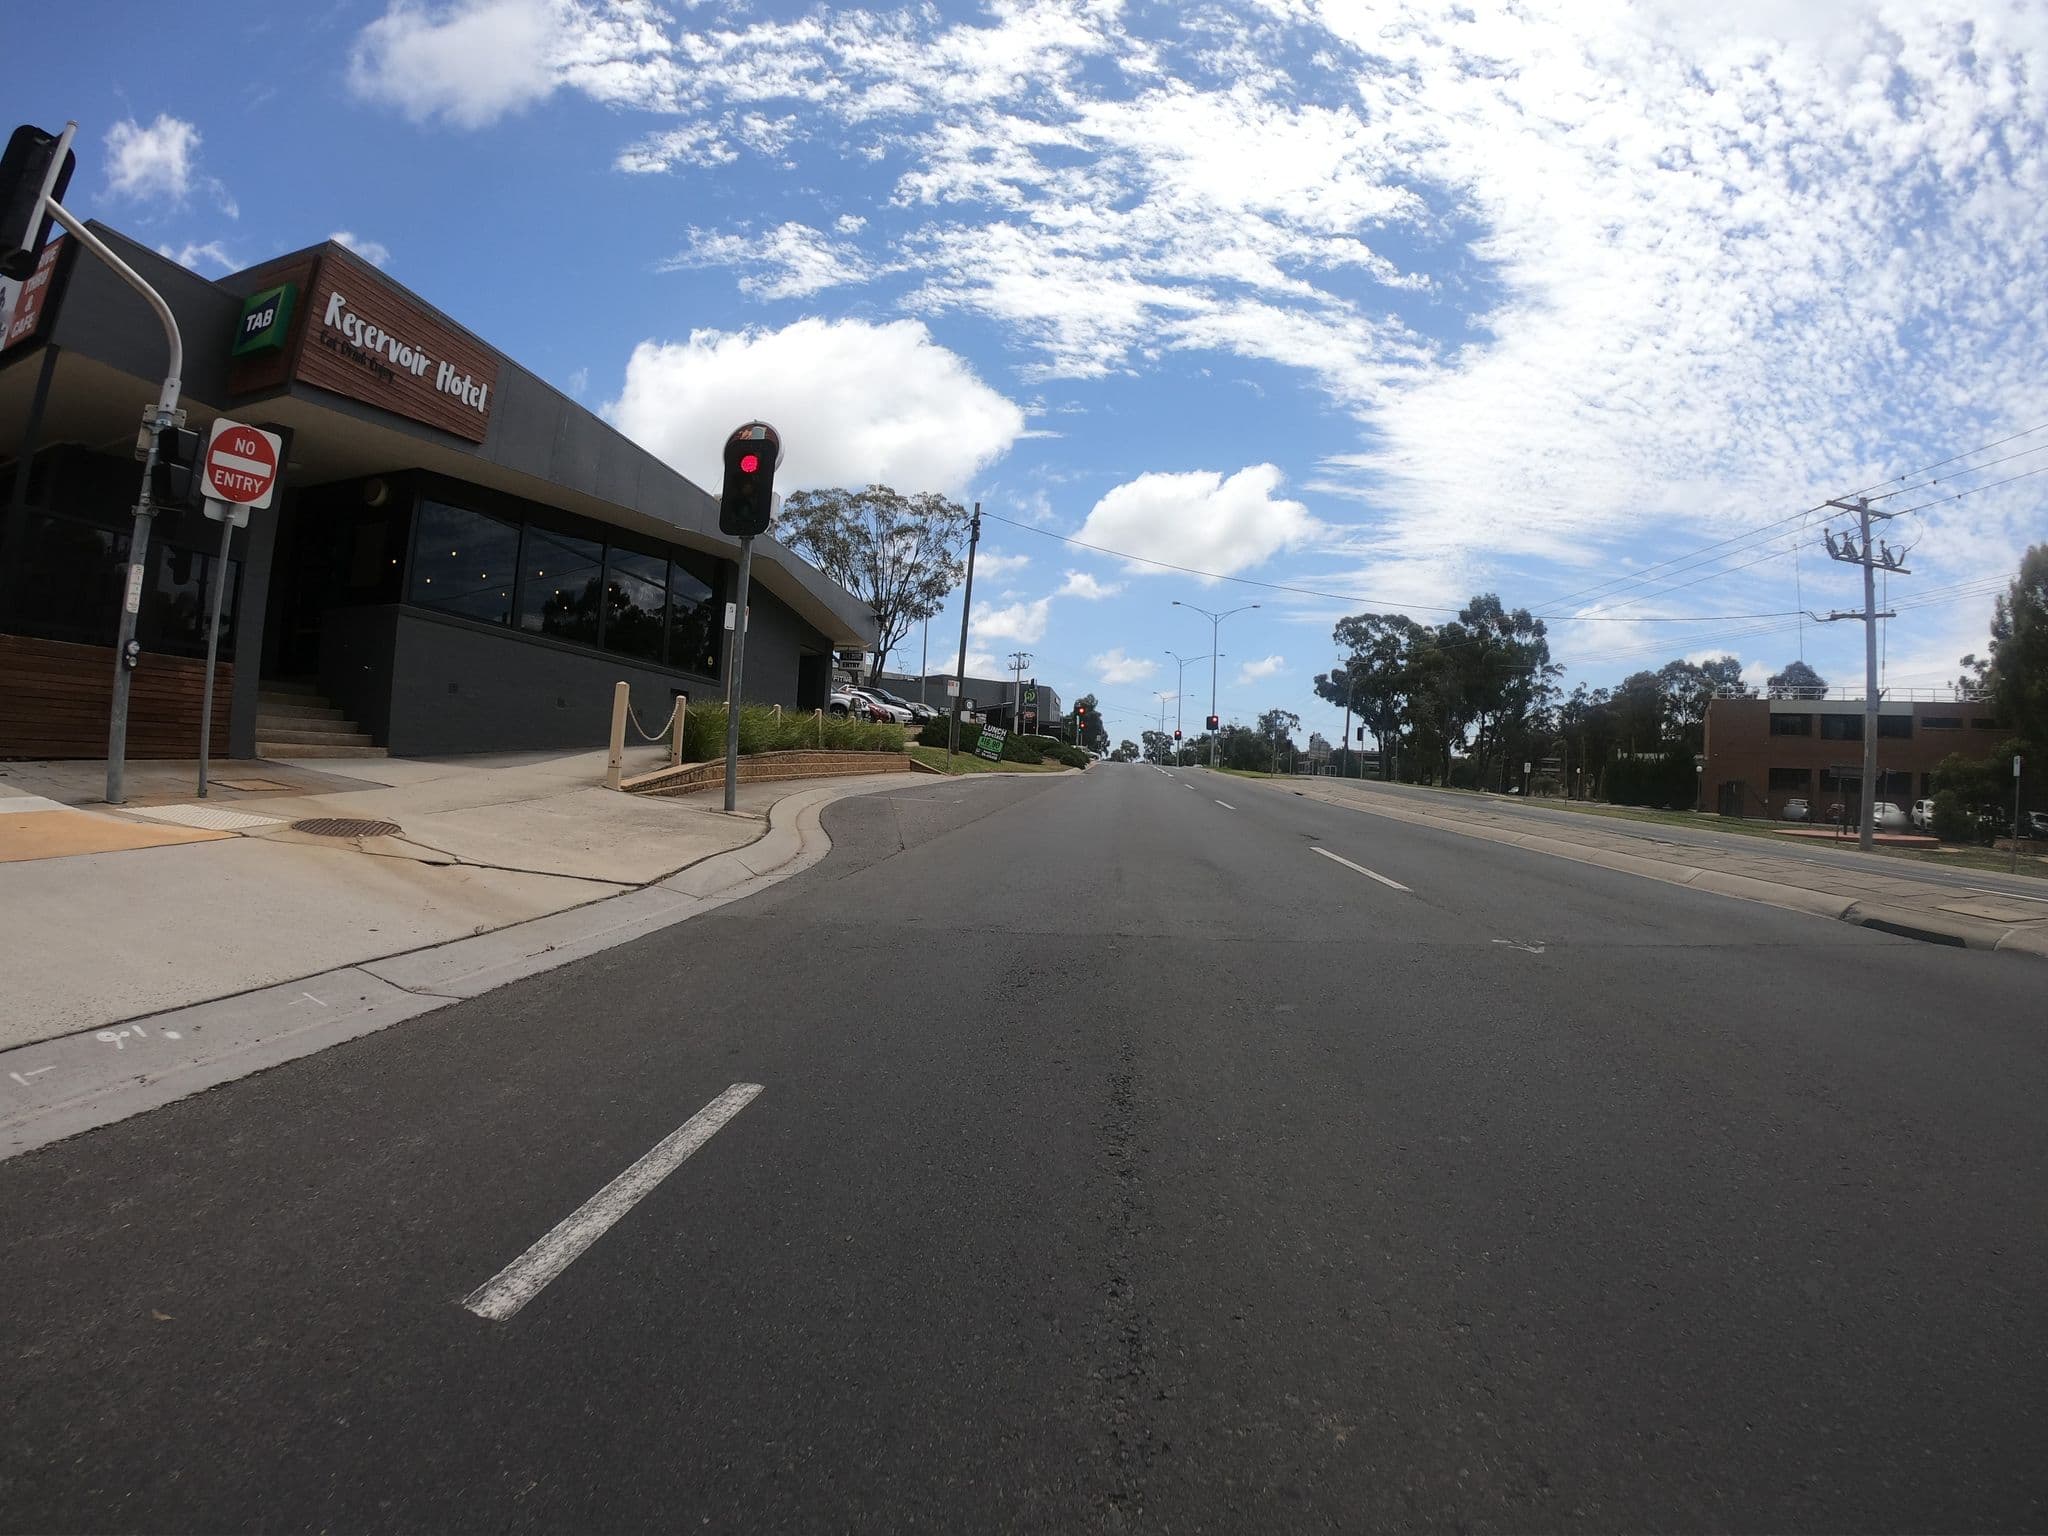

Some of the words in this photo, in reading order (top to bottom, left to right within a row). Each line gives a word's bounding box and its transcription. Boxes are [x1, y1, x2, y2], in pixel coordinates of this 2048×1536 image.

[246, 308, 274, 332] TAB
[324, 291, 432, 377] Reservoir
[435, 360, 488, 413] Hotel
[234, 437, 256, 456] NO
[214, 469, 264, 494] ENTRY
[983, 723, 1008, 737] LUNCH
